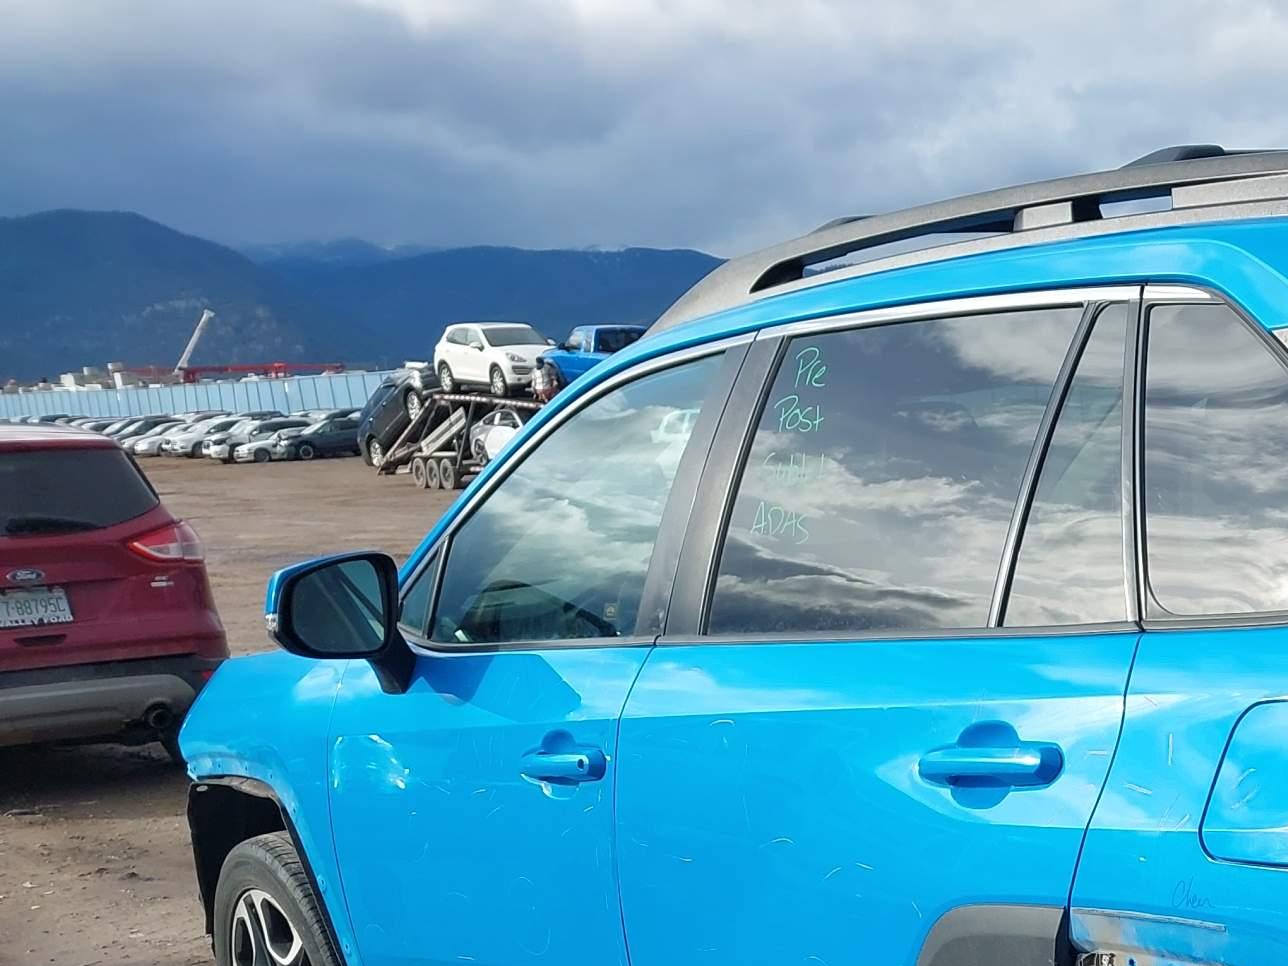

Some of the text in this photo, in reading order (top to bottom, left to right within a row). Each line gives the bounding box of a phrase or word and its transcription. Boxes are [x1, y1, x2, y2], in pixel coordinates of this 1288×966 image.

[794, 347, 828, 388] Pre
[773, 395, 825, 433] Post
[750, 501, 811, 545] ADAS
